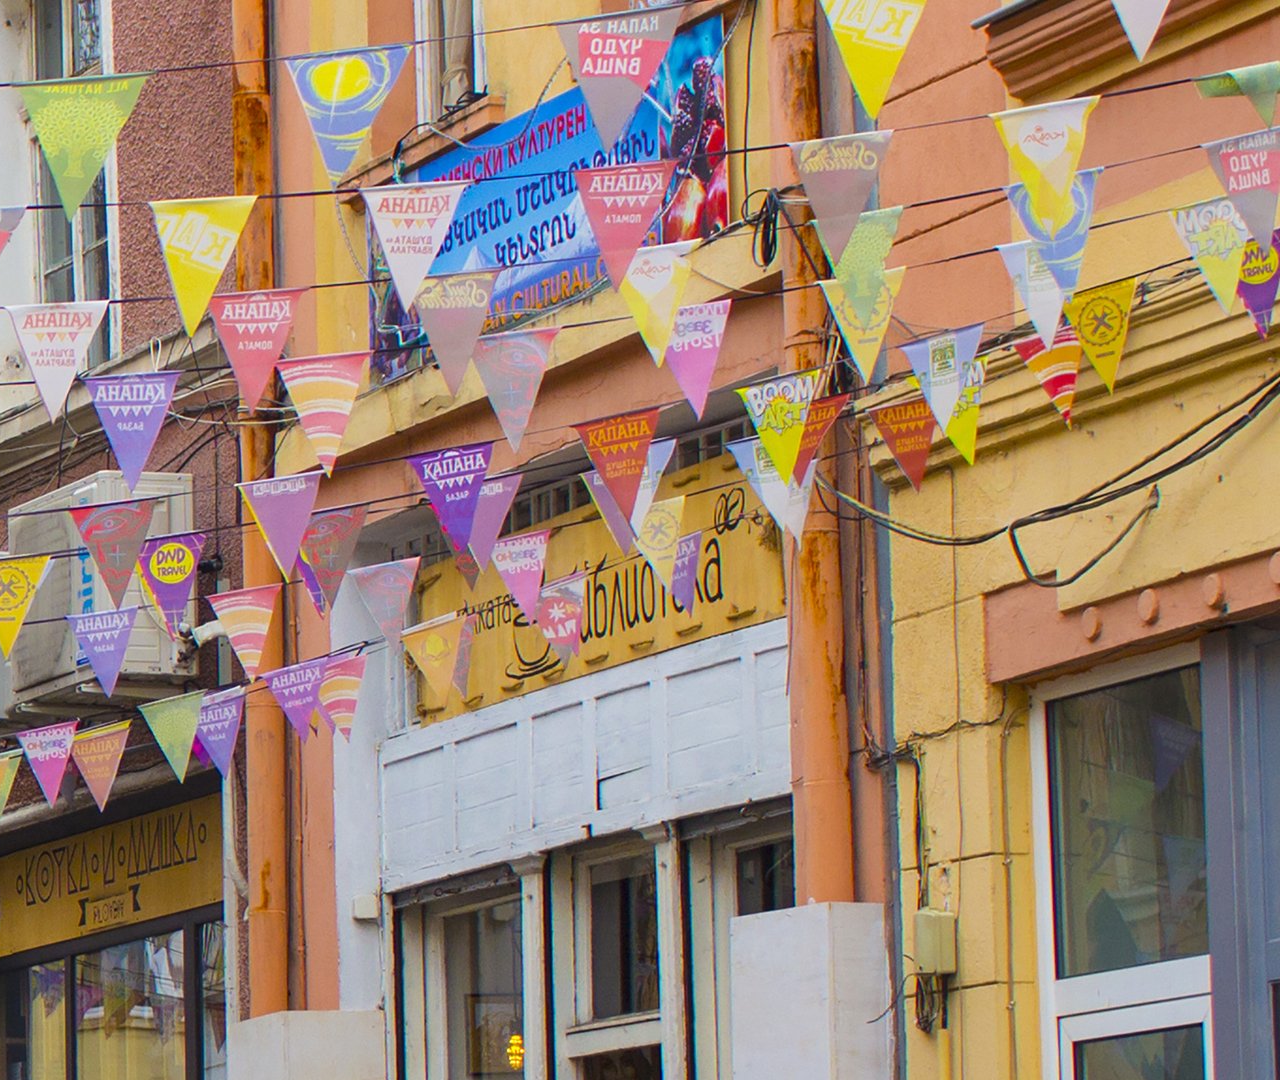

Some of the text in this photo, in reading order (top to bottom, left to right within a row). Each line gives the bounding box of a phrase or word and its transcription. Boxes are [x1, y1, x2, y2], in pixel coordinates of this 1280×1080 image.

[507, 104, 587, 168] КУЛТУРЕН
[1242, 262, 1273, 278] TRAVEL
[512, 268, 592, 320] CULTURAL
[745, 378, 816, 416] BOOM
[757, 401, 807, 432] ART
[877, 403, 933, 423] КАПАНА
[588, 420, 650, 447] КАПАНА
[423, 452, 487, 480] КАПАНА
[606, 459, 640, 470] ДУШАТА
[445, 490, 470, 502] БАЗАР
[155, 549, 186, 565] DND
[157, 563, 187, 577] TRAVEL
